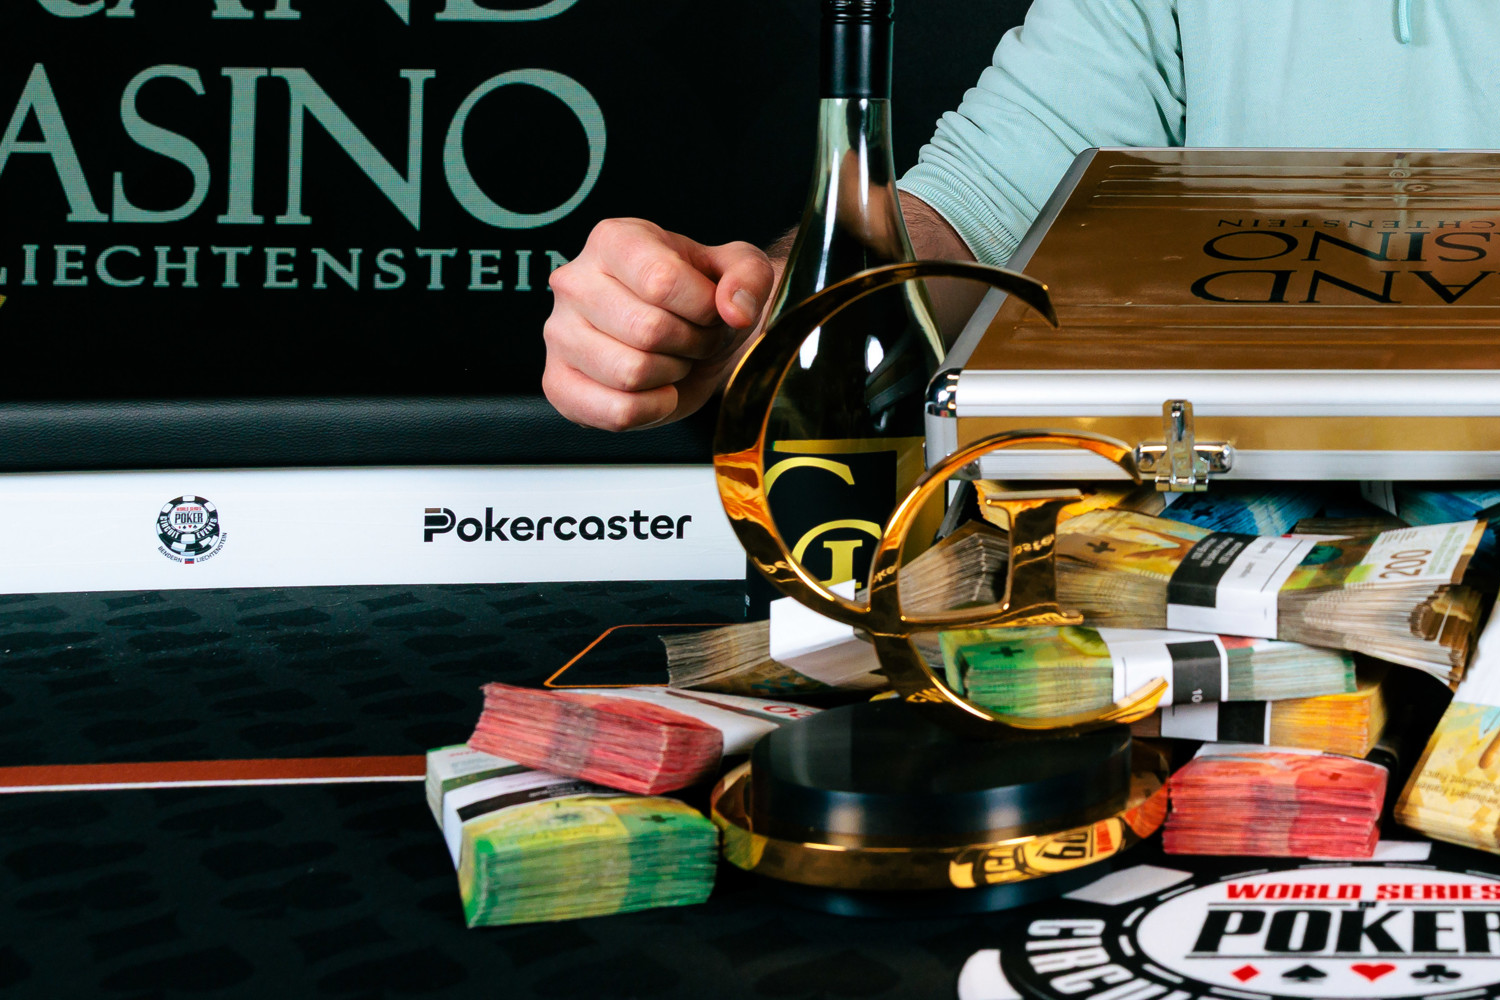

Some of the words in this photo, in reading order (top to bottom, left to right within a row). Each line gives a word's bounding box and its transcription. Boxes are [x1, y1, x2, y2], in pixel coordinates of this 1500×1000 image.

[175, 513, 203, 524] POKER
[424, 507, 692, 543] Pokercaster
[1226, 884, 1362, 900] WORLD
